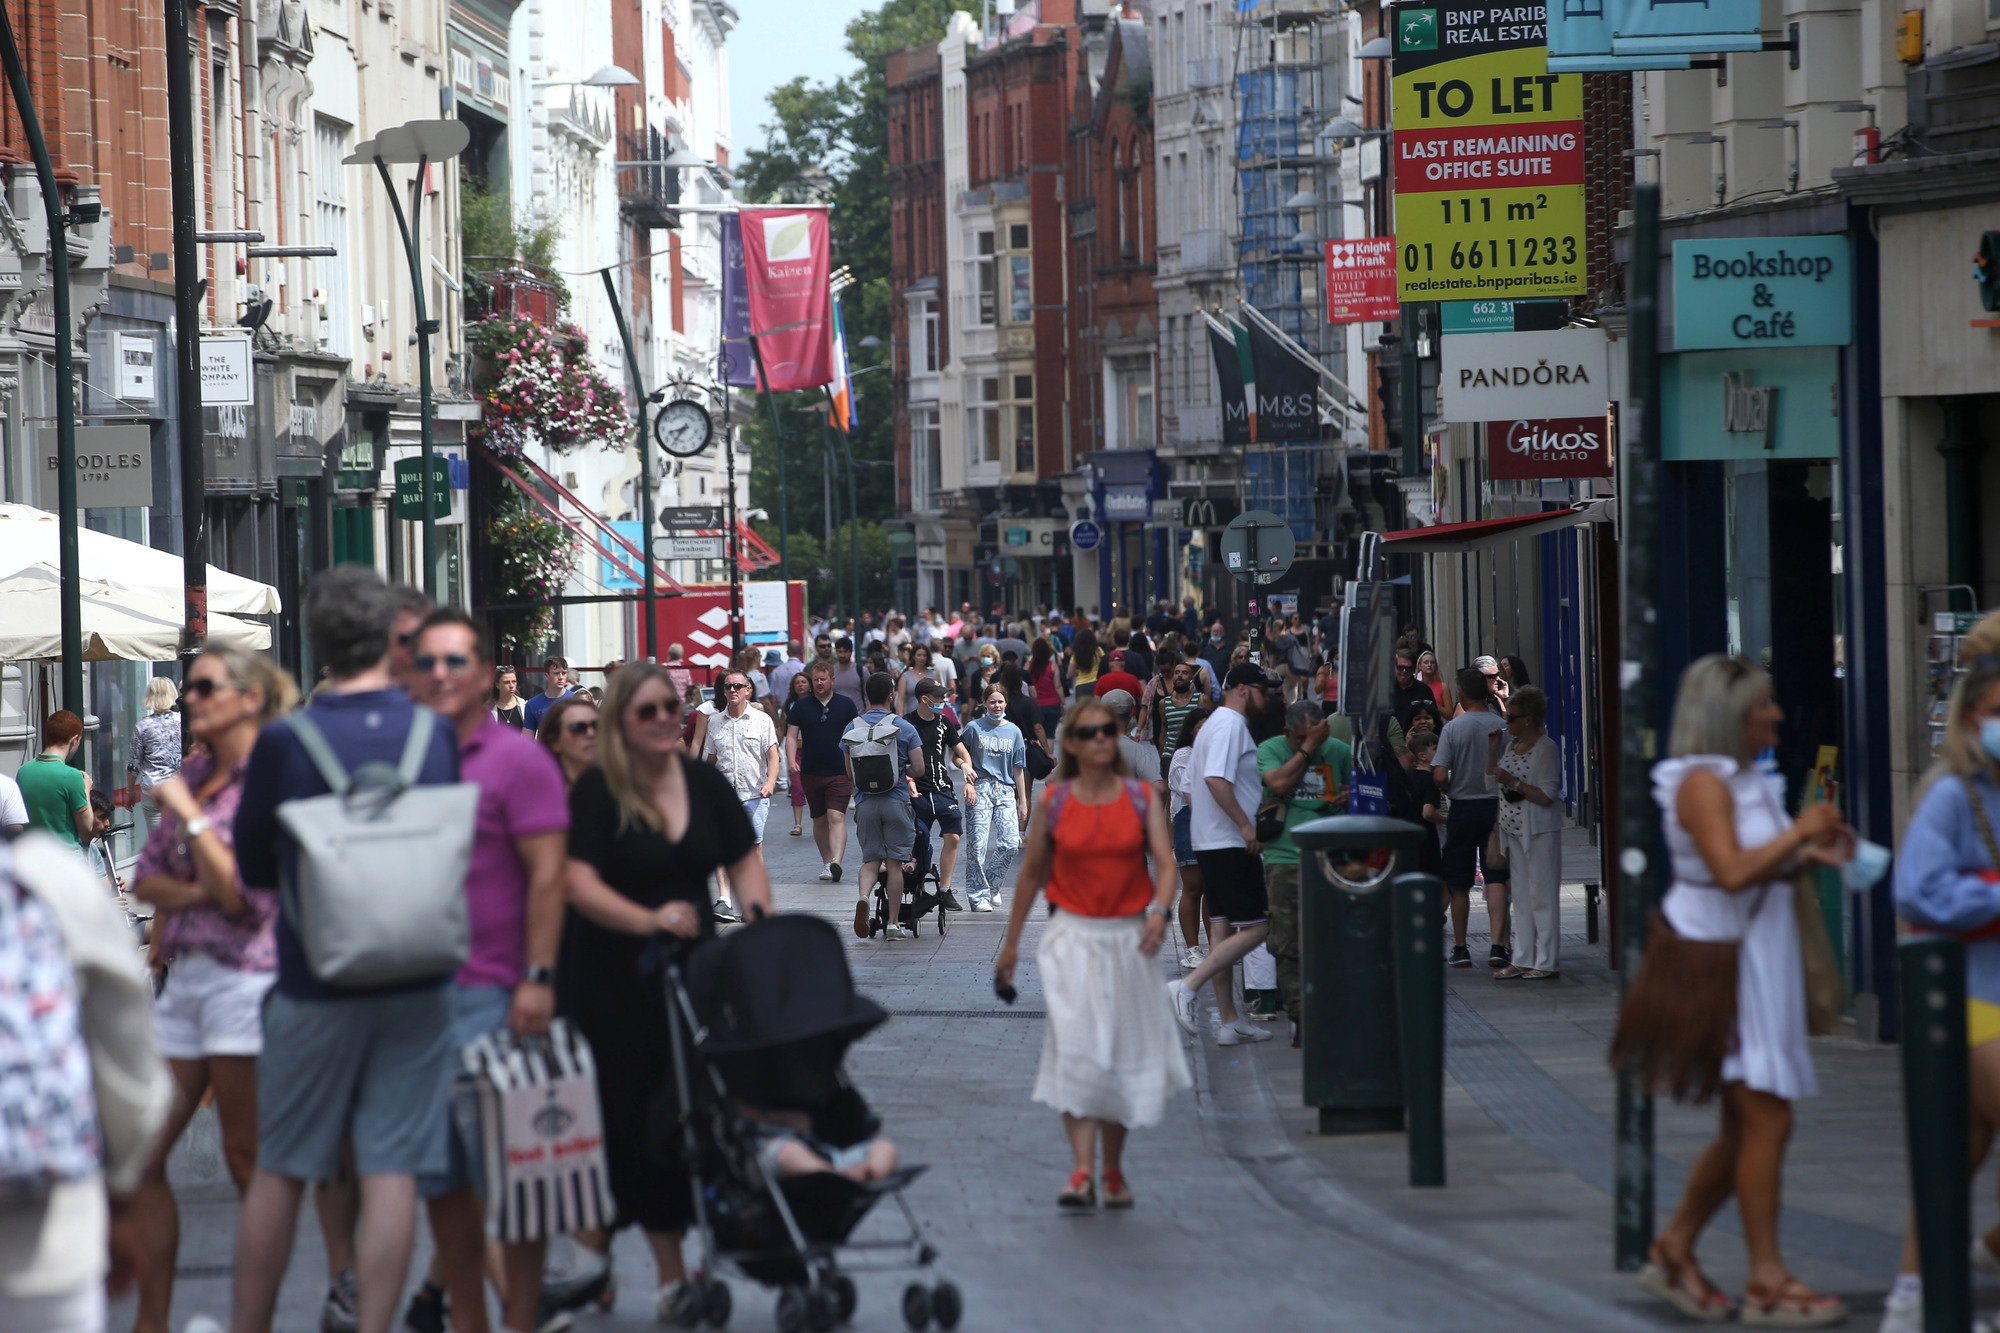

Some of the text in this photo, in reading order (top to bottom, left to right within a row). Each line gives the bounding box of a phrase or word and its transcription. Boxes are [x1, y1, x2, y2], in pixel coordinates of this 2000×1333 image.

[1446, 10, 1485, 26] BNP
[1490, 6, 1547, 23] PARIB
[1446, 24, 1548, 44] REAL ESTA
[1413, 75, 1559, 118] TO LET
[1402, 133, 1576, 159] LAST REMAINING
[1426, 157, 1552, 181] OFFICE SUITE
[1441, 198, 1491, 224] 111
[1356, 241, 1391, 255] Knight
[1404, 236, 1577, 272] 01 6611233
[767, 264, 812, 279] Kaizen
[1357, 255, 1386, 267] Frank
[1692, 250, 1833, 282] Bookshop
[1333, 270, 1362, 280] FITTED
[1405, 271, 1577, 292] realestate.bnpparibas.ie
[1334, 281, 1366, 291] TO LET
[1753, 283, 1775, 308] &
[1473, 302, 1496, 314] 662
[1732, 311, 1796, 339] Café
[201, 373, 239, 381] OMPANY
[1460, 360, 1589, 388] PANDORA
[1260, 394, 1312, 417] M&S
[1507, 419, 1599, 456] Gino's
[48, 454, 142, 471] BODLES
[1531, 451, 1589, 461] GELATO
